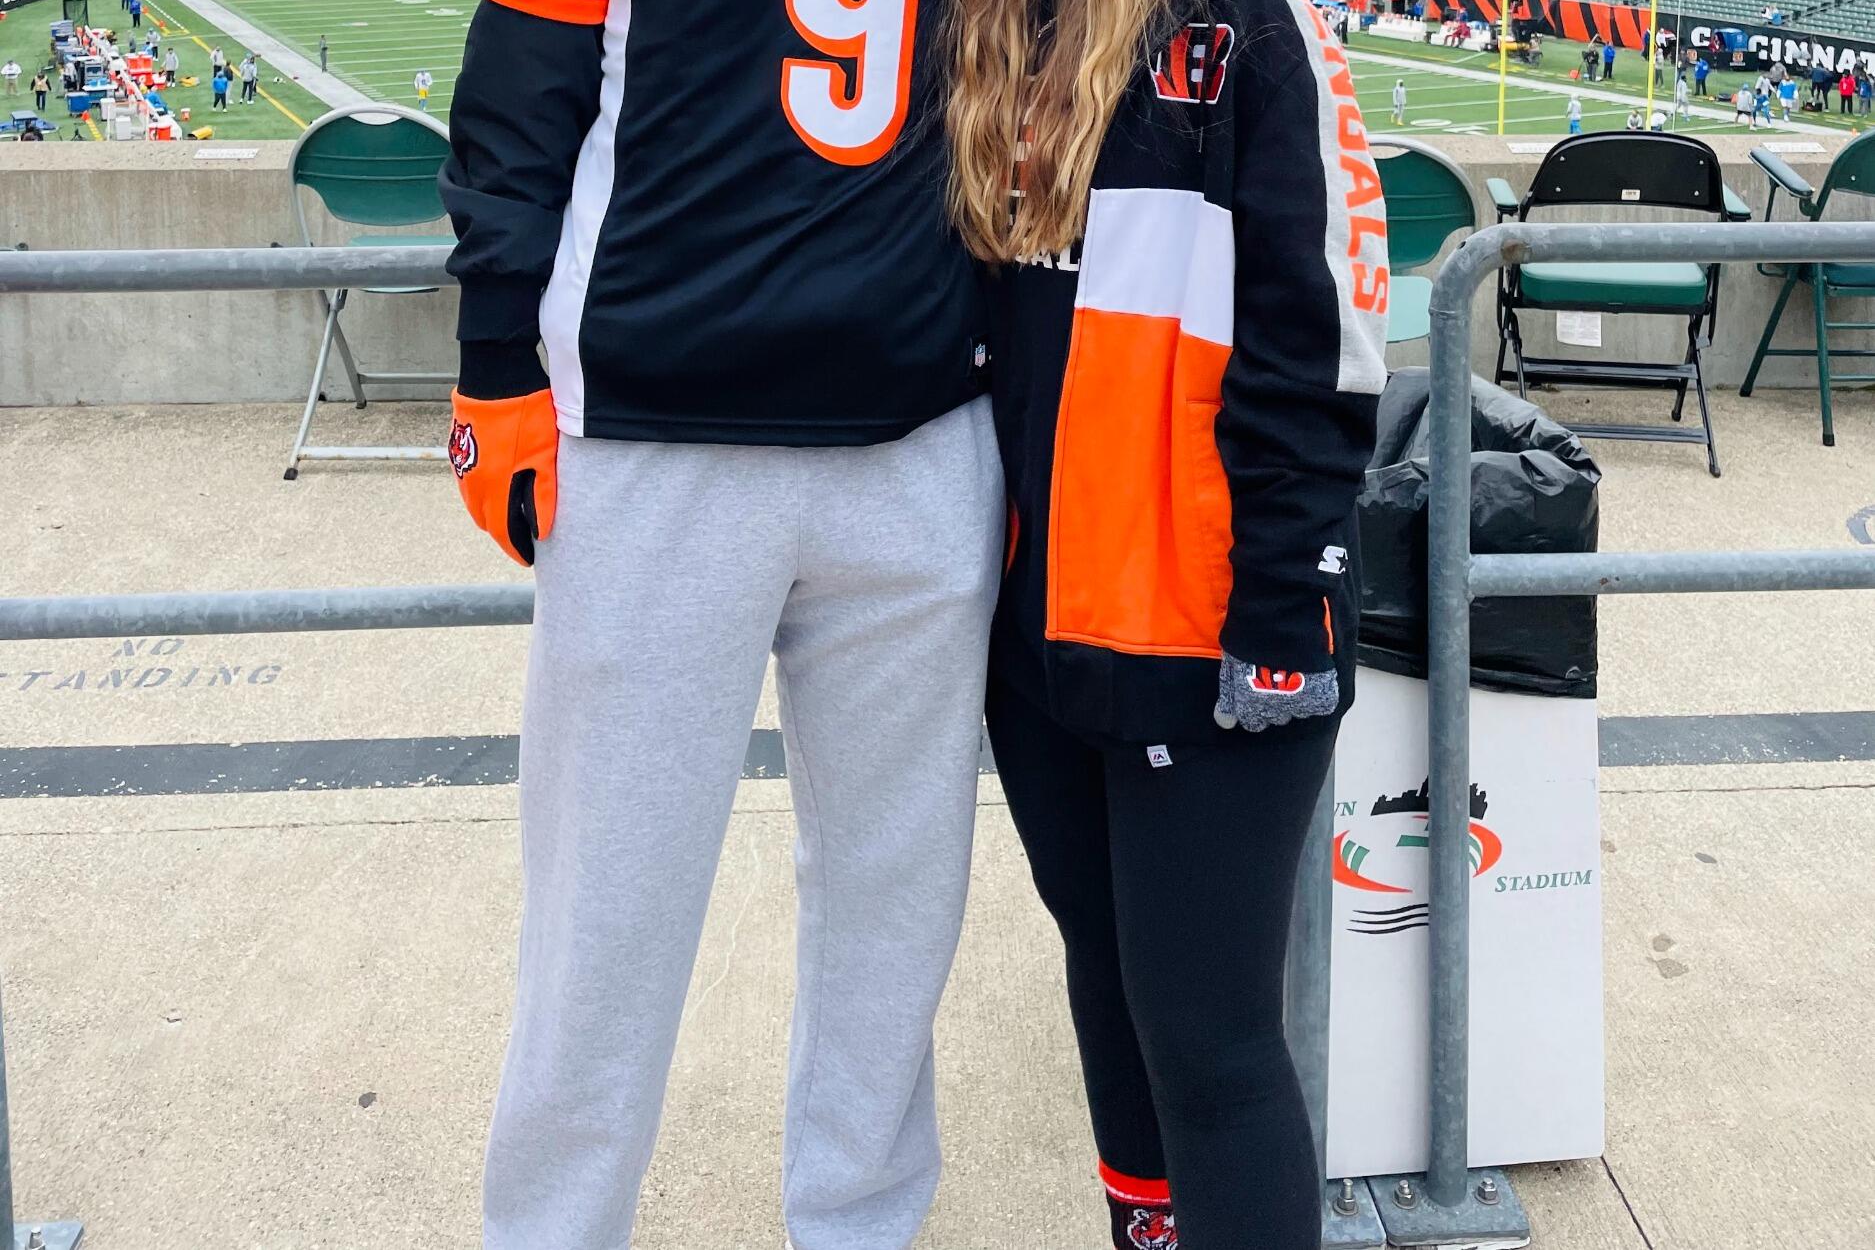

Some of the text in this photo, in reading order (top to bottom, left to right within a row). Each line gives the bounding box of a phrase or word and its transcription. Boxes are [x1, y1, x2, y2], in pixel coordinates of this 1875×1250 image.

[110, 638, 185, 657] NO
[0, 664, 282, 691] TANDING
[1494, 869, 1592, 893] STADIUM
